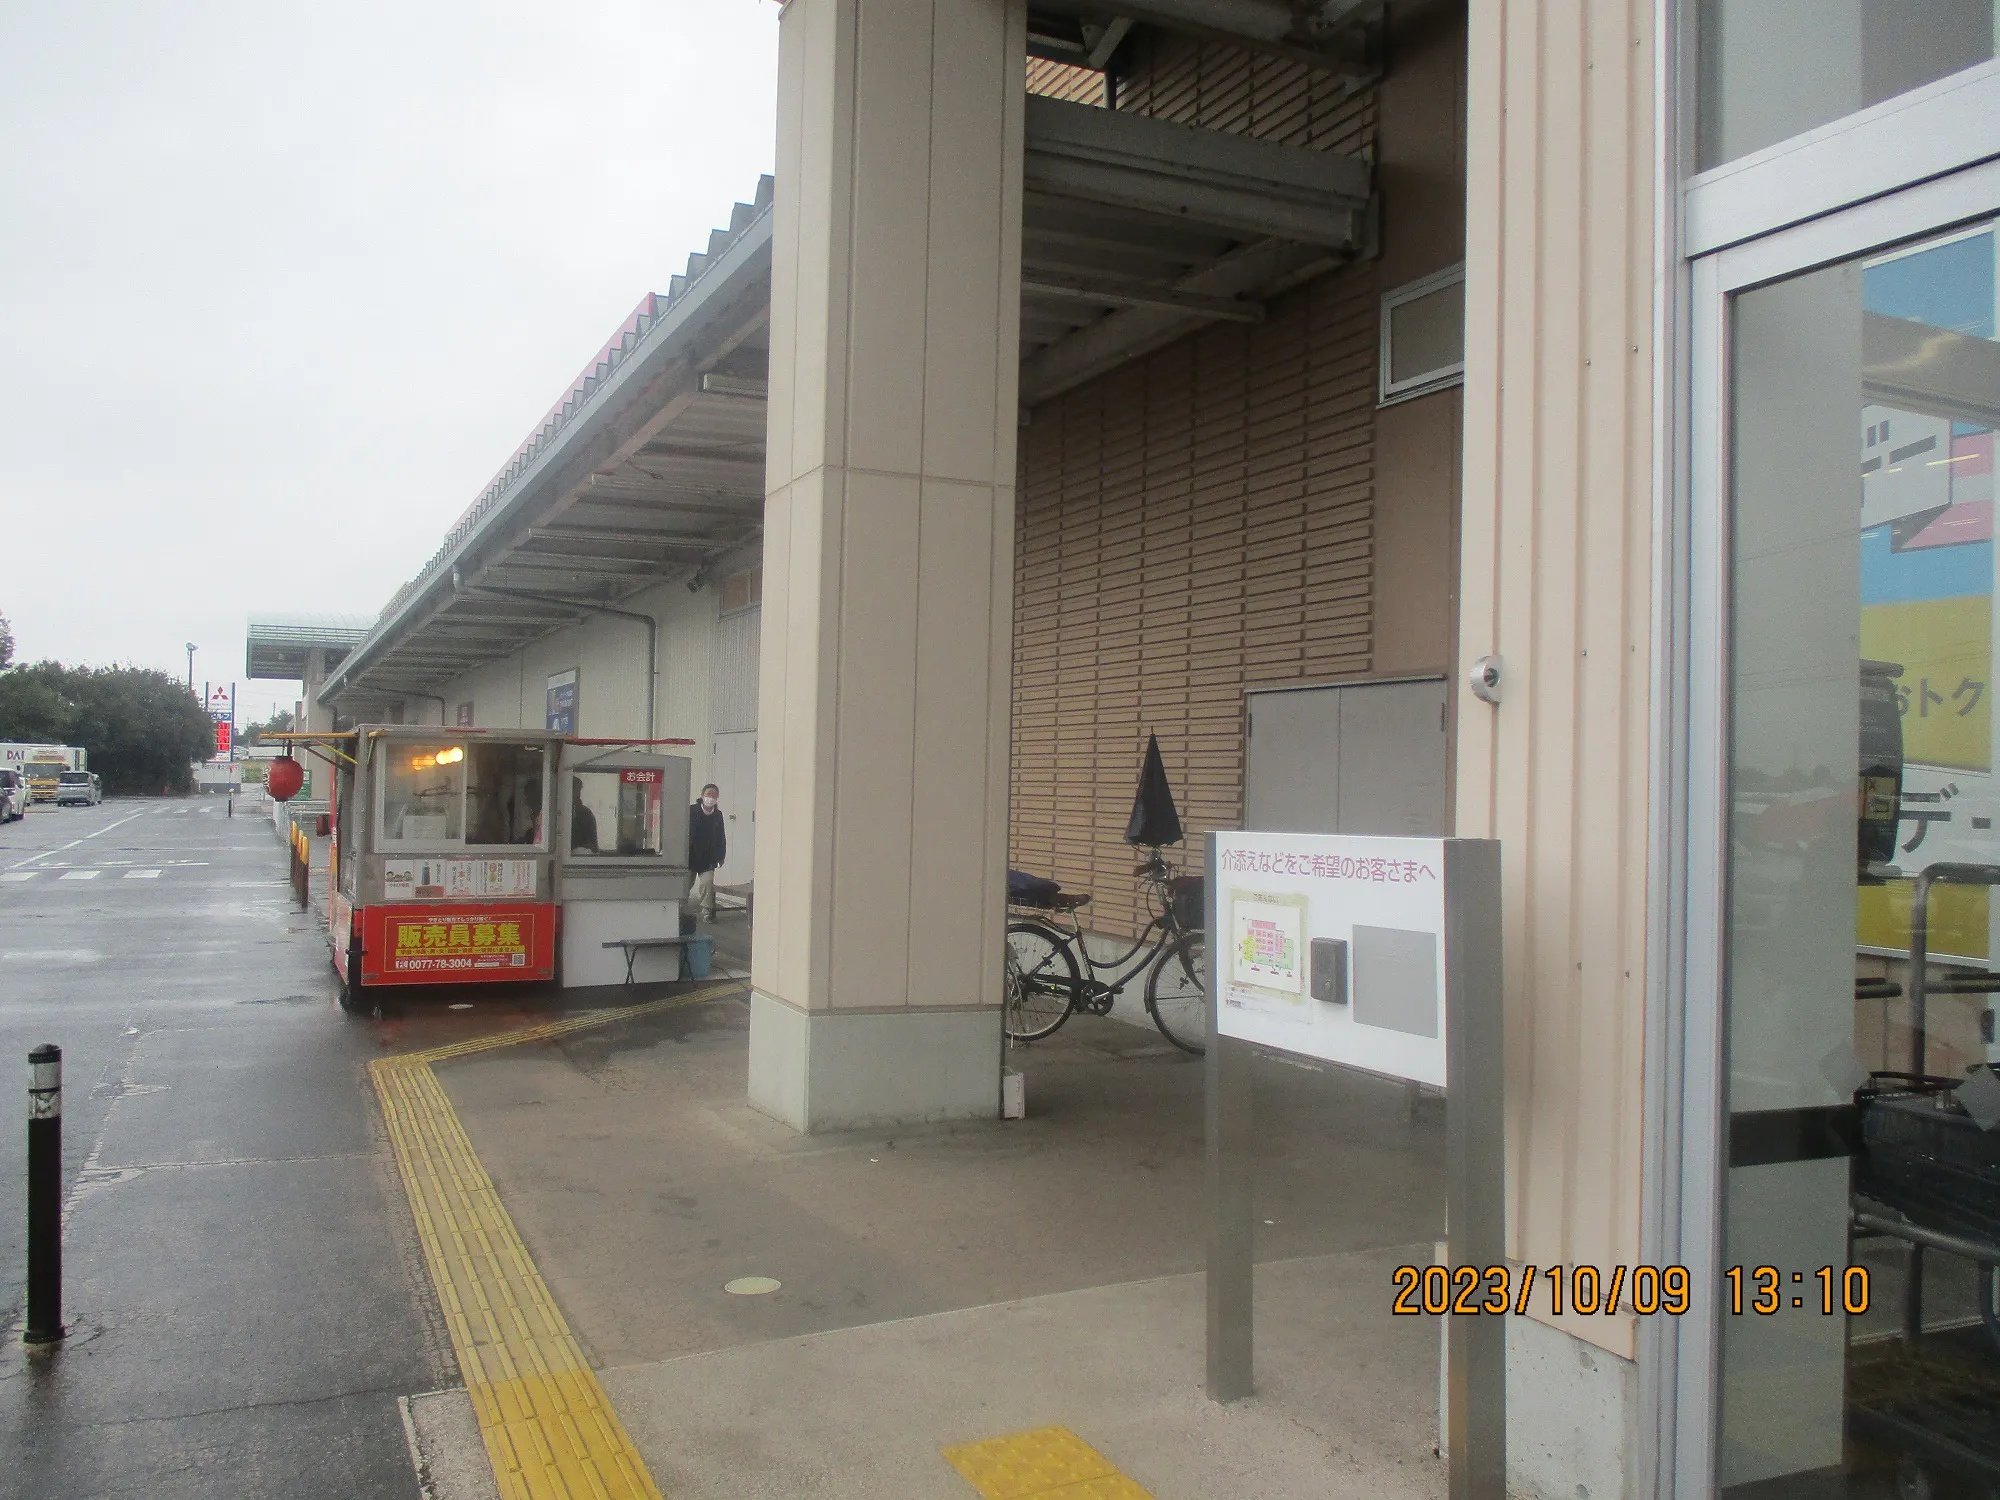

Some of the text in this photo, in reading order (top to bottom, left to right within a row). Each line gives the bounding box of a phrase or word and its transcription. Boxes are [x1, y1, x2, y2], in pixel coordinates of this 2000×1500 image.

[626, 771, 656, 782] お会計
[1221, 848, 1436, 883] 介添えなどをご希望のお客さまへ
[398, 924, 520, 948] 販売員募集
[409, 958, 472, 970] 0077-78-3004
